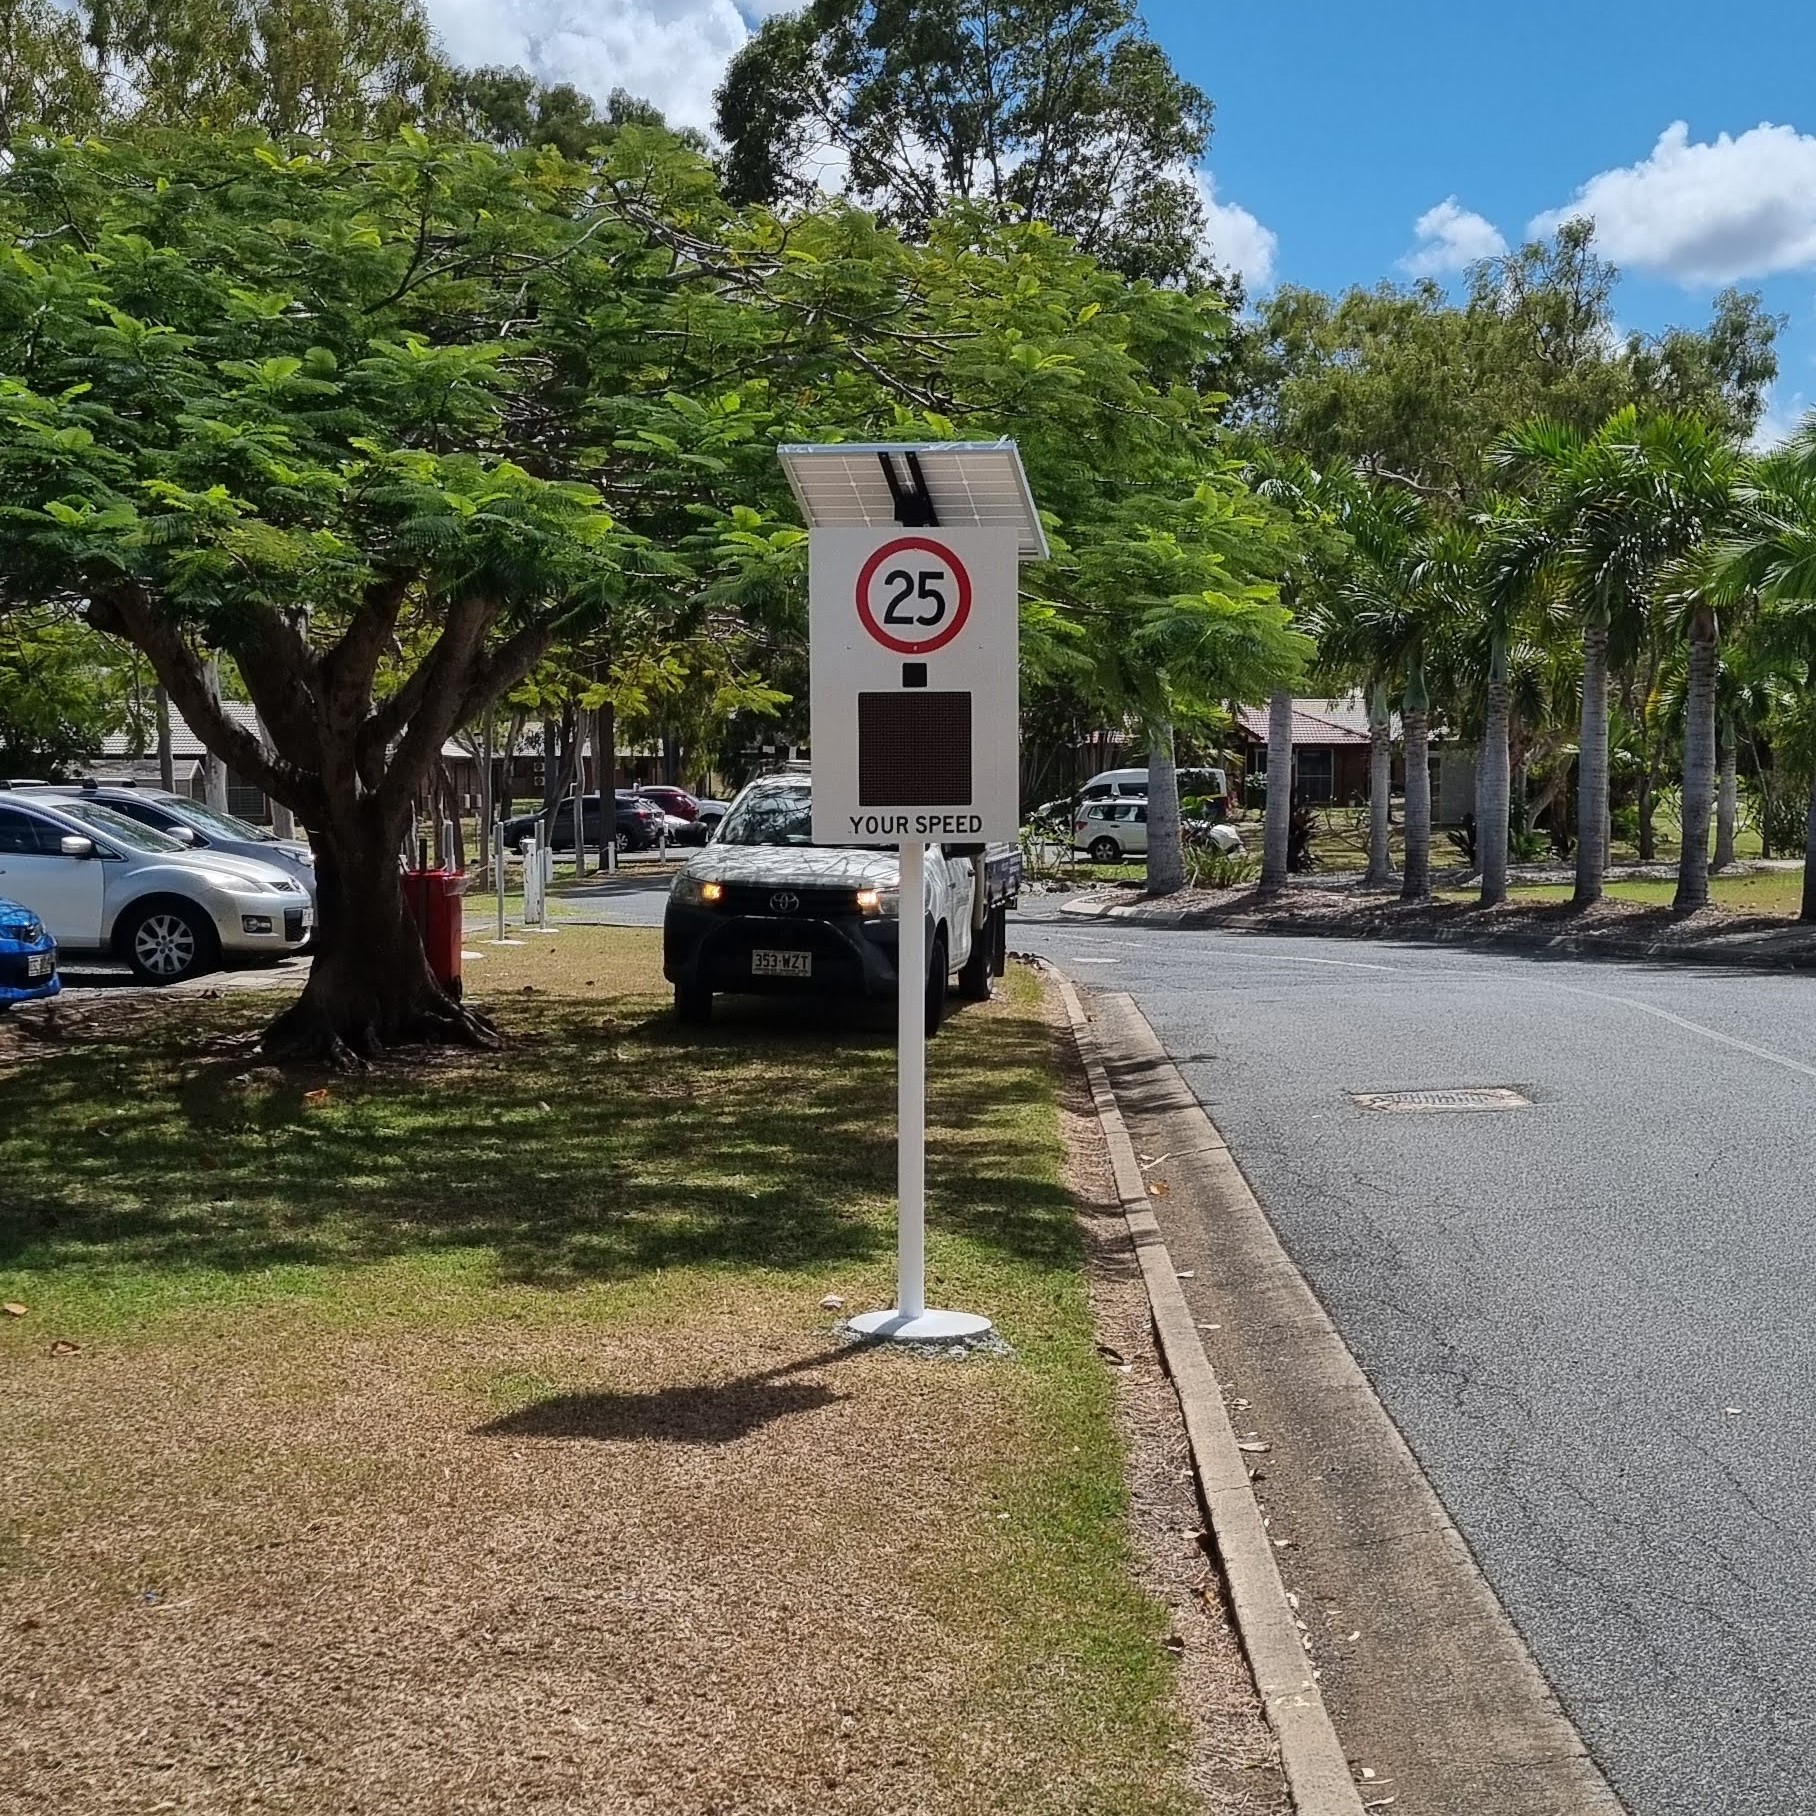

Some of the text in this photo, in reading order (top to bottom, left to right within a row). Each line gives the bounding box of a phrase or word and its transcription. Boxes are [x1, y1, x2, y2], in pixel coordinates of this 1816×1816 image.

[884, 570, 945, 626] 25
[849, 815, 982, 834] YOUR SPEED
